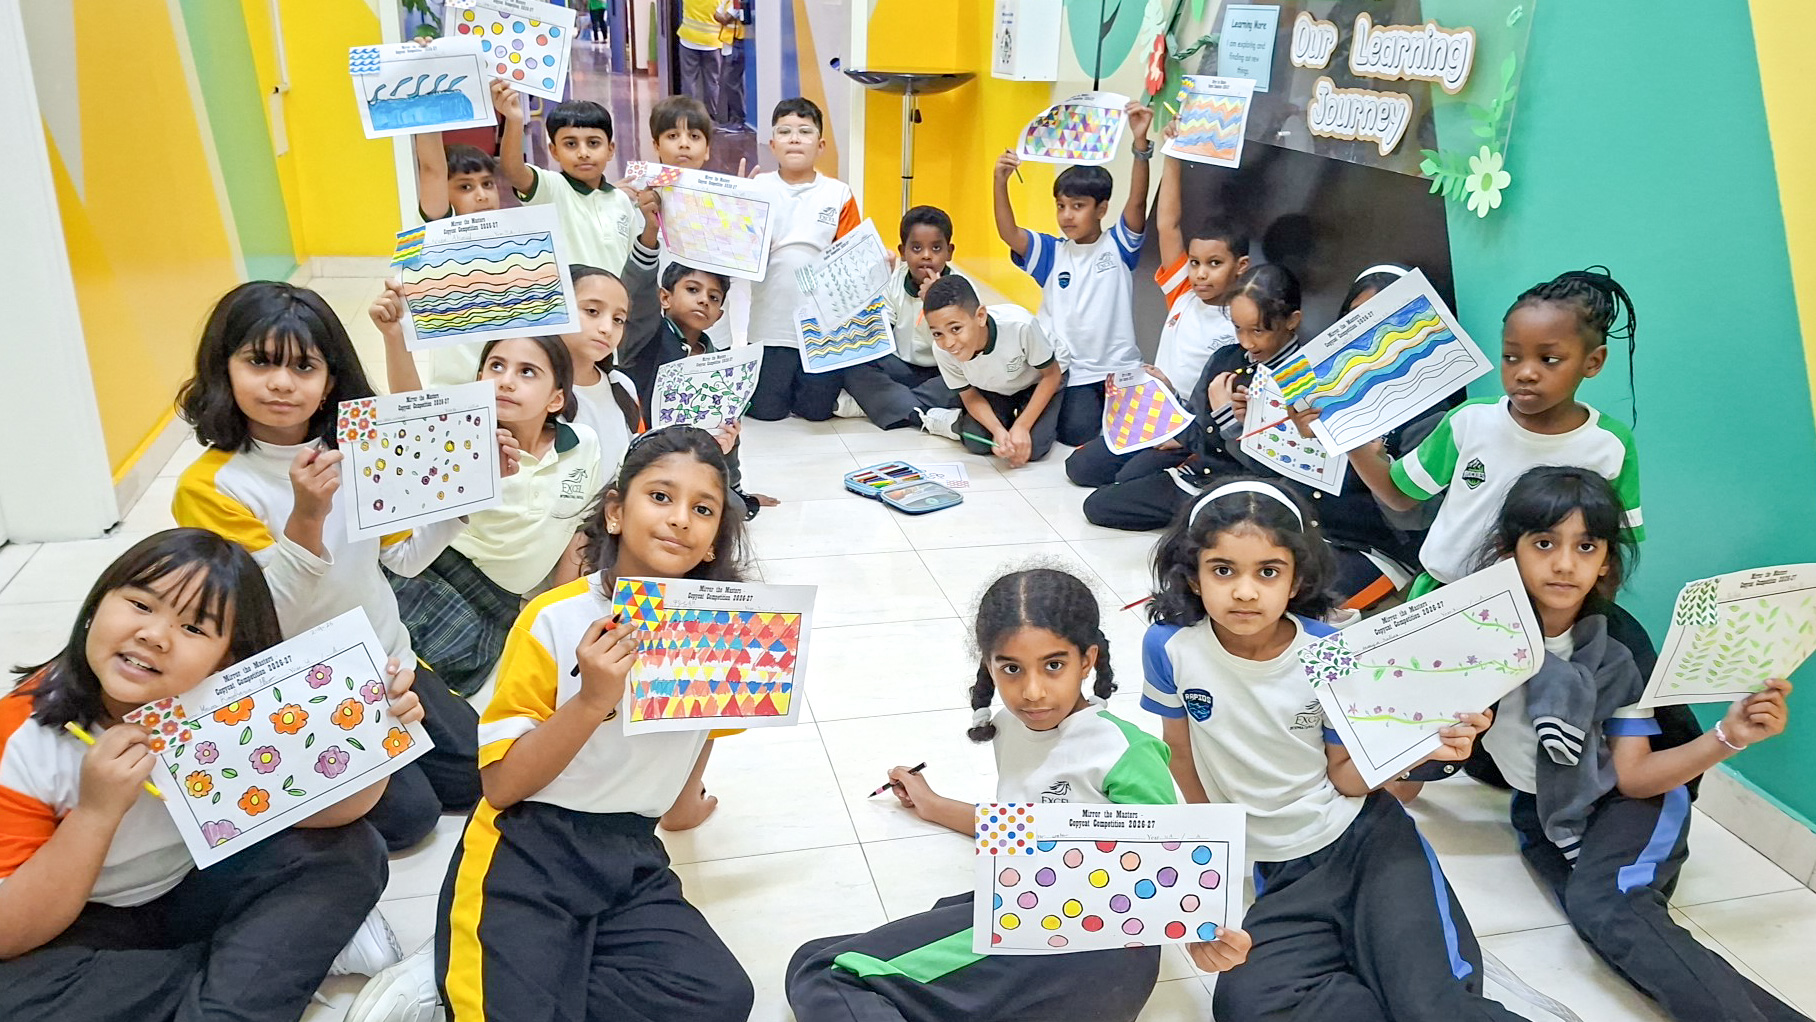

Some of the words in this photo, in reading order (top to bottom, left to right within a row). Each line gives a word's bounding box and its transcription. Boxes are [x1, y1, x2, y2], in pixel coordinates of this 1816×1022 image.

[1231, 19, 1252, 31] Learning
[1296, 19, 1334, 59] Our
[1356, 21, 1468, 83] Learning
[1312, 86, 1406, 146] Journey
[562, 483, 584, 494] EXCEL
[699, 585, 714, 593] Mirror
[688, 592, 705, 601] Copycat
[706, 593, 731, 602] Competition
[1381, 613, 1397, 625] Mirror
[1409, 602, 1428, 613] Masters
[1374, 624, 1393, 636] Copycat
[1394, 612, 1421, 628] Competition
[222, 669, 241, 683] Mirror
[243, 666, 251, 674] the
[253, 656, 274, 669] Masters
[215, 683, 236, 696] Copycat
[237, 668, 266, 686] Competition
[1185, 693, 1212, 704] RAPIDS
[1082, 809, 1101, 818] Mirror
[1104, 810, 1113, 818] the
[1116, 810, 1138, 818] Masters
[1069, 819, 1090, 829] Copycat
[1093, 819, 1125, 829] Competition
[1128, 819, 1156, 828] 2026-27
